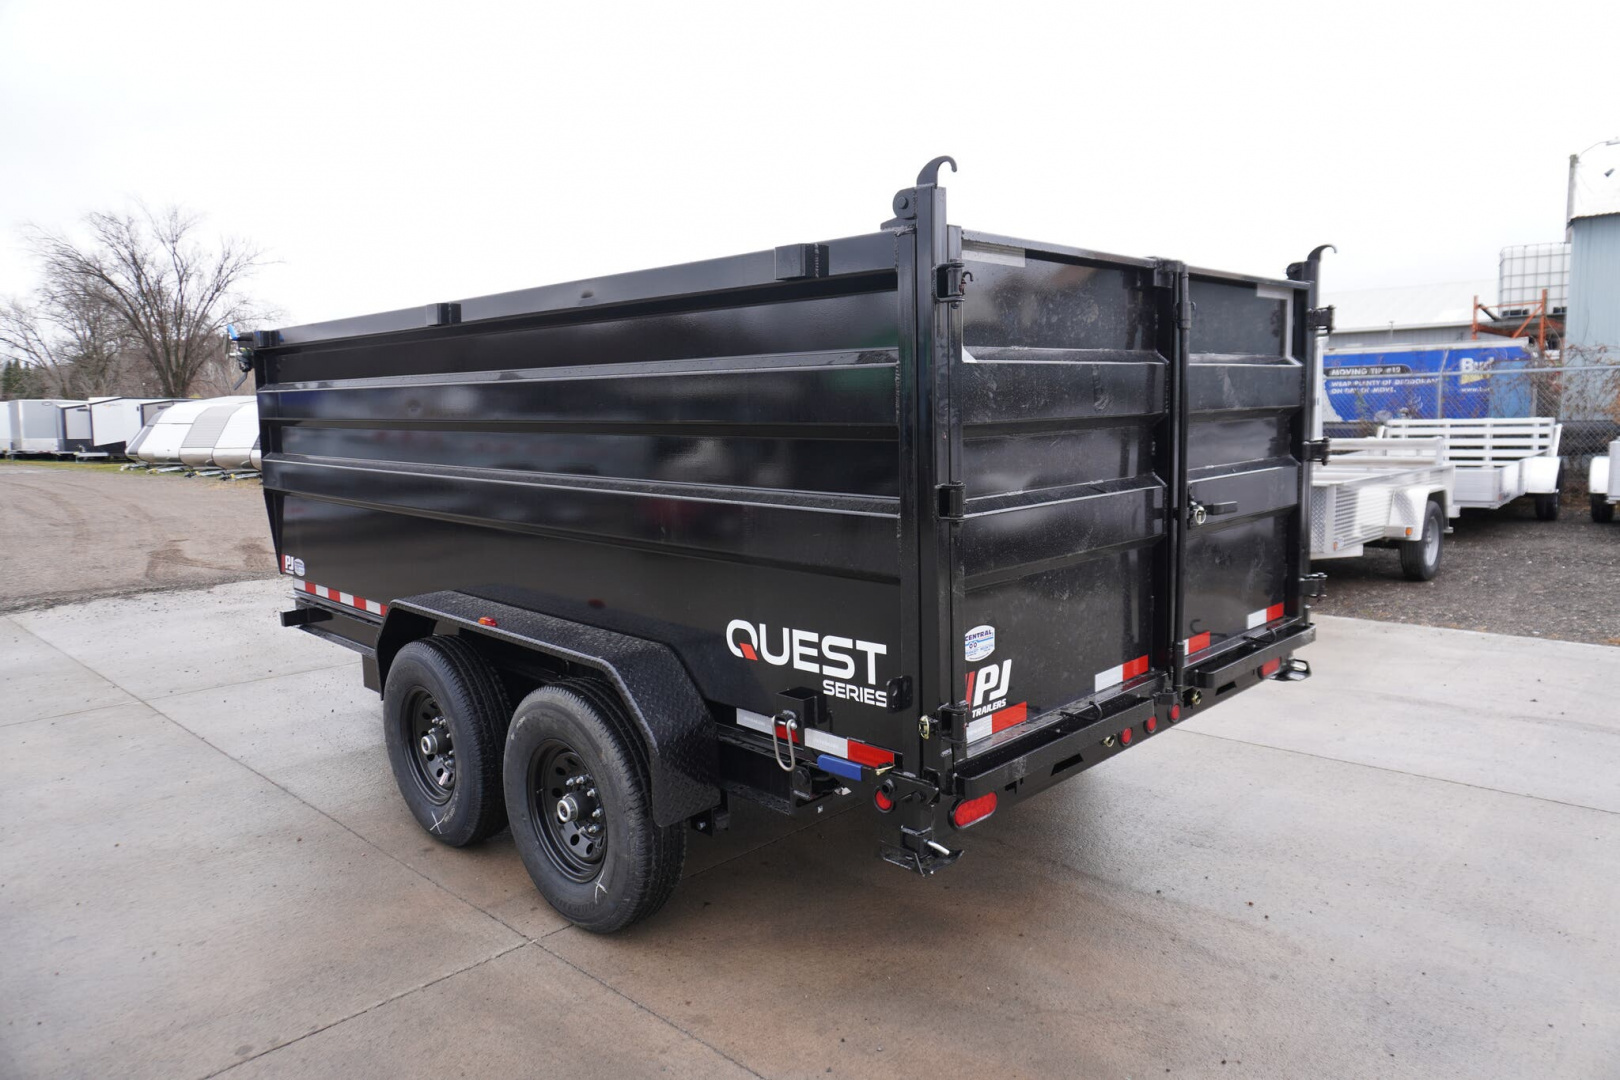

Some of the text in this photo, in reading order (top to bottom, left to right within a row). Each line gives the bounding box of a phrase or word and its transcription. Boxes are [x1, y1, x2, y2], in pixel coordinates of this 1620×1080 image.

[1331, 367, 1368, 376] MOVING
[1371, 367, 1384, 375] TIP
[965, 629, 992, 642] CENTRAL
[726, 619, 887, 685] QUEST
[823, 680, 887, 707] SERIES
[973, 659, 1012, 707] PJ
[972, 698, 1007, 718] TRAILERS
